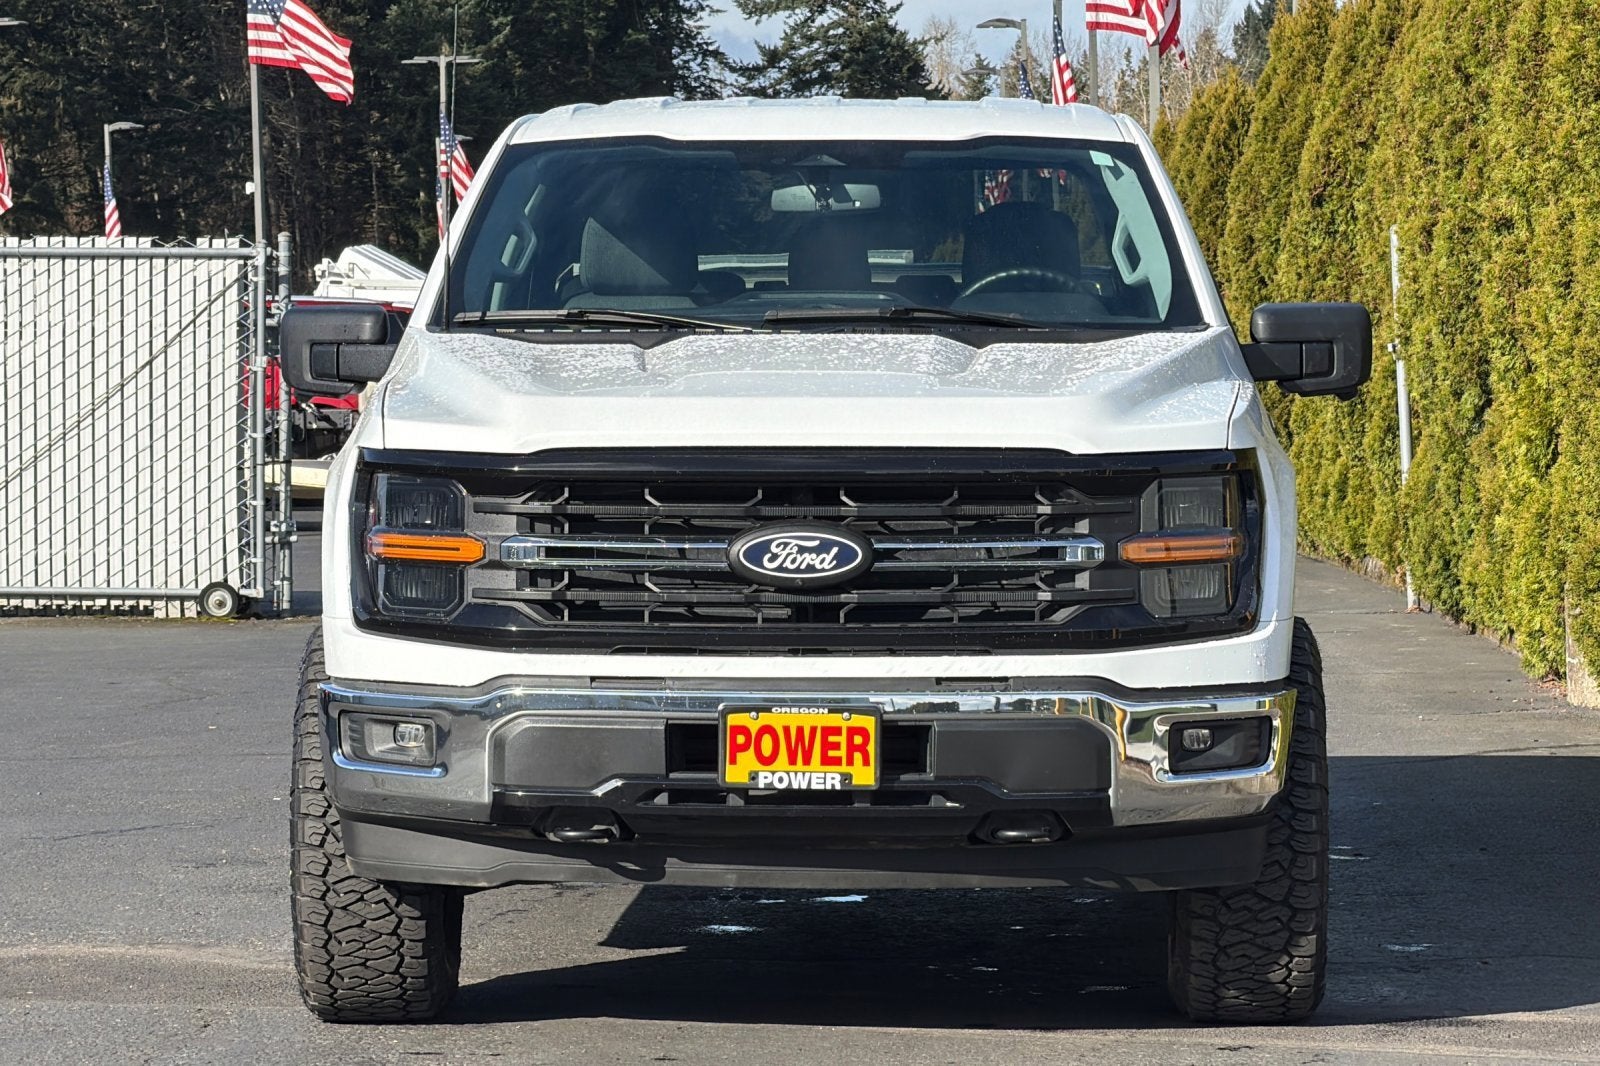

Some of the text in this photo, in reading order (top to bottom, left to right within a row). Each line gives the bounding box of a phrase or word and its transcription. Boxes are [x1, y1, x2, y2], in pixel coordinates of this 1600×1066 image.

[762, 538, 839, 569] Ford
[771, 706, 828, 714] OREGON
[729, 724, 871, 767] POWER
[758, 771, 841, 790] POWER
